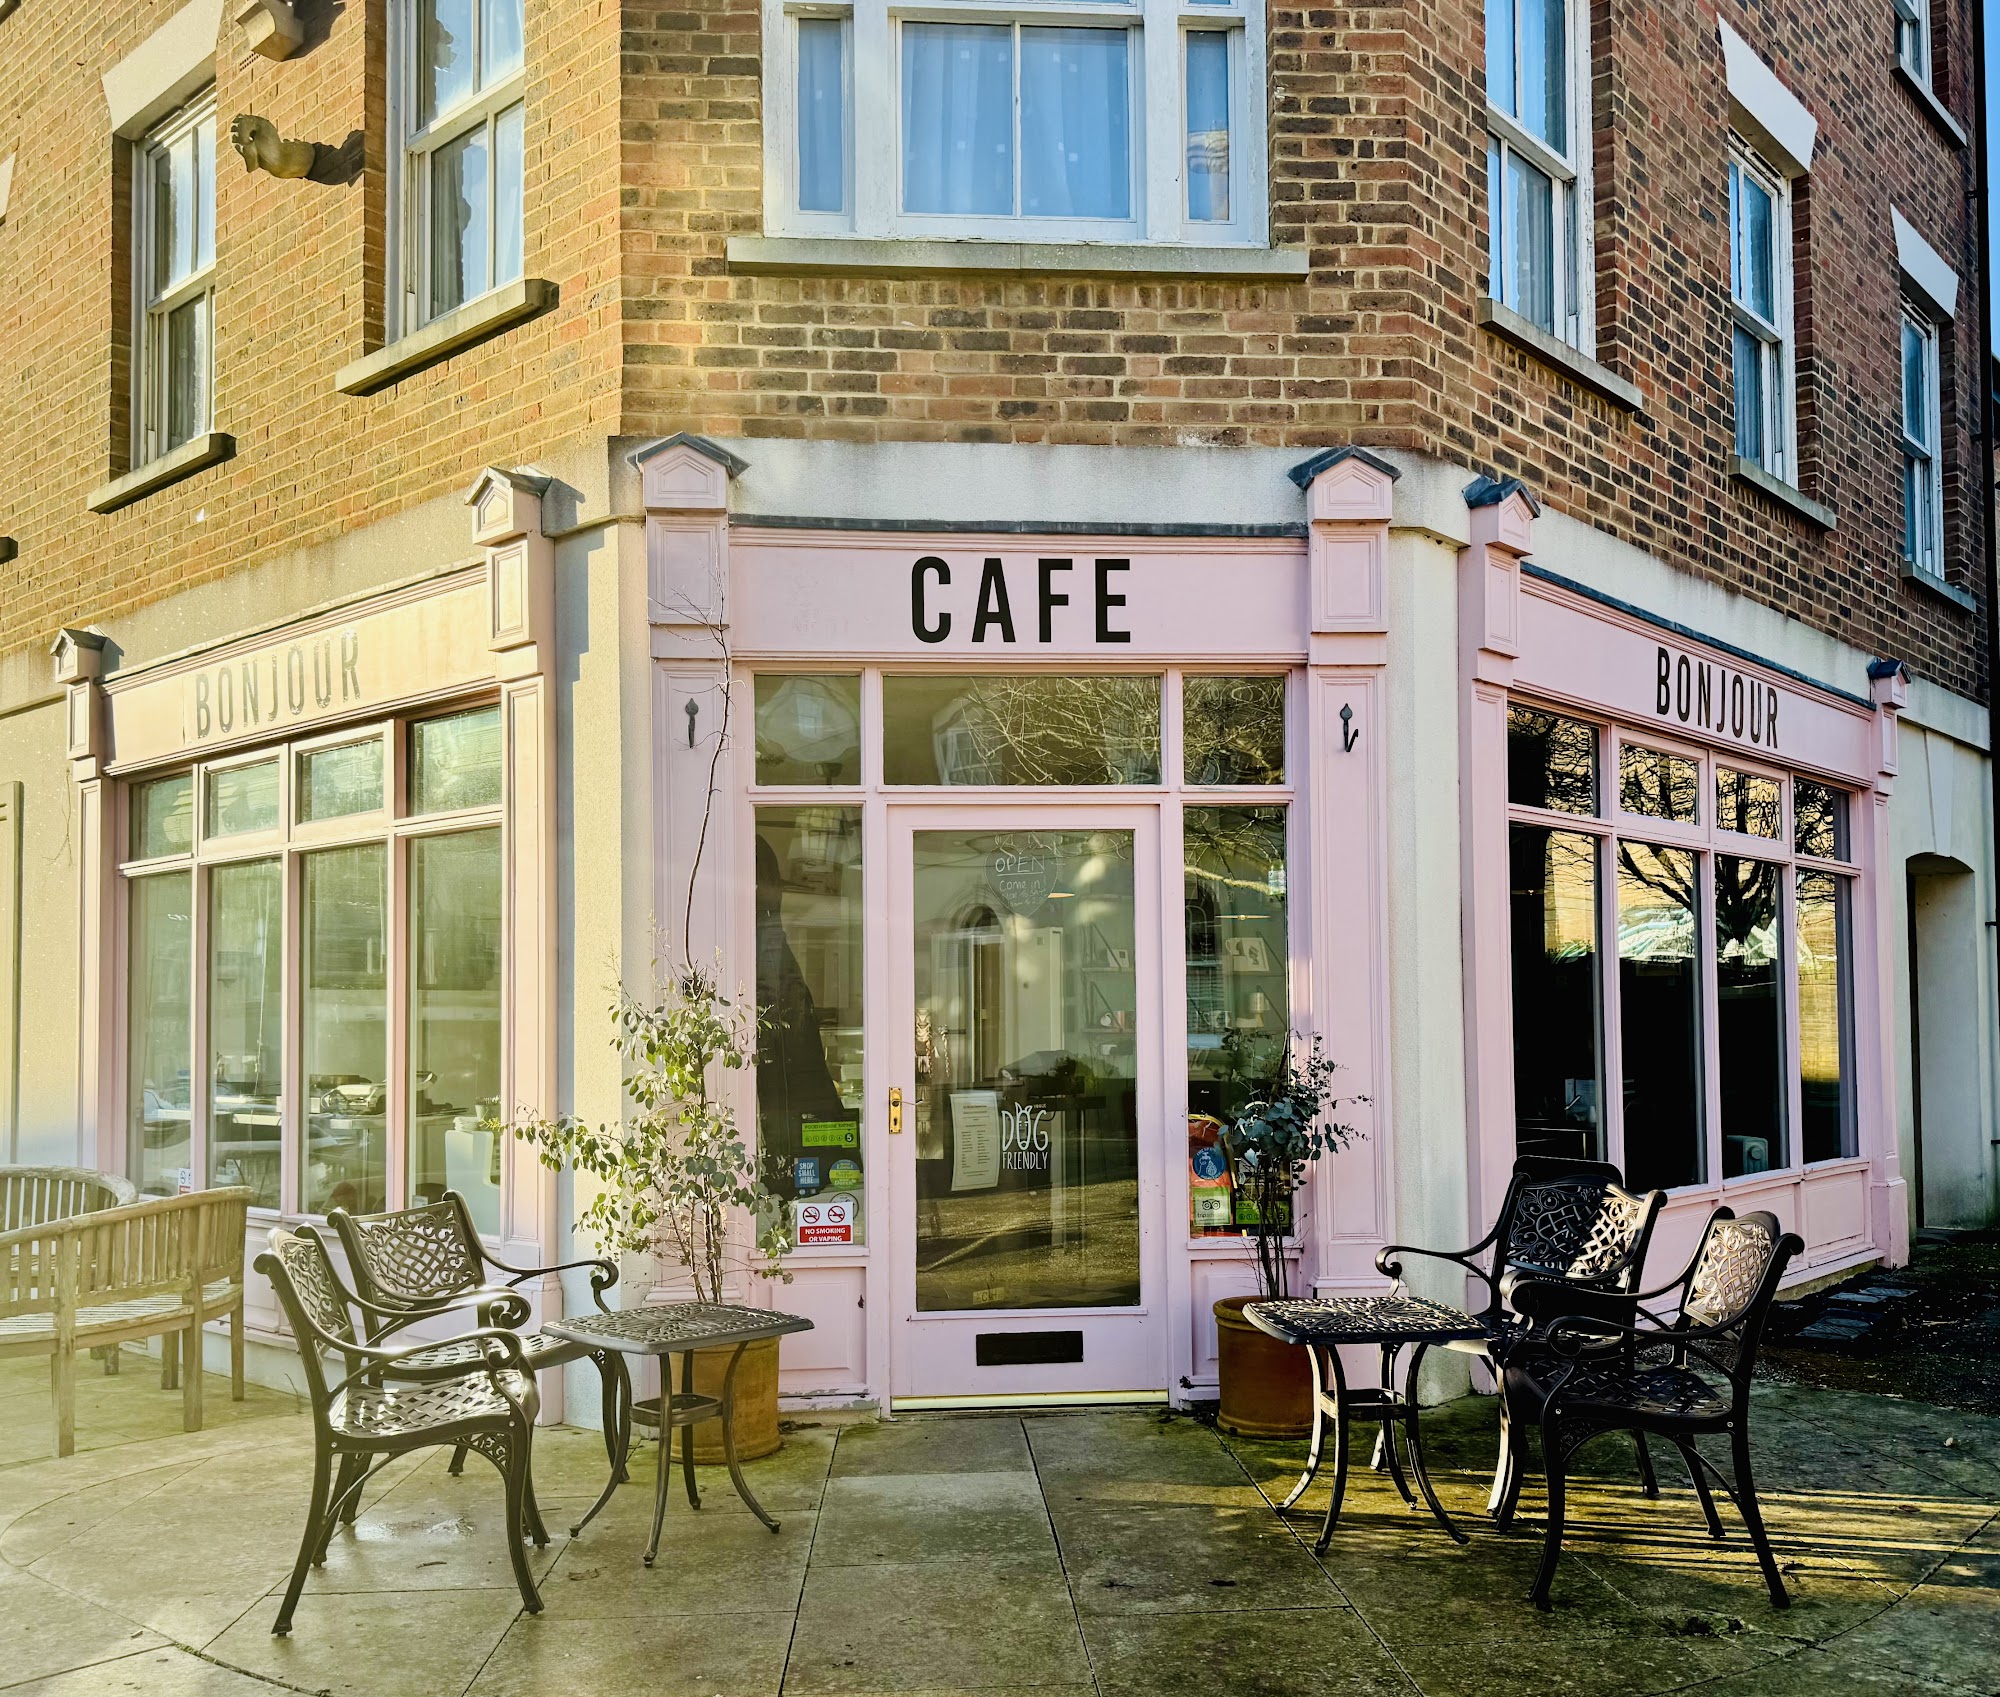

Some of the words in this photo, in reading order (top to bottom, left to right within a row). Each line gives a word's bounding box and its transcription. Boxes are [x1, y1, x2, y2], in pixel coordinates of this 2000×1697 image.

[911, 556, 1131, 643] CAFE
[195, 628, 361, 740] BONJOUR
[1656, 646, 1778, 749] BONJOUR
[995, 854, 1045, 873] OPEN
[1001, 1103, 1049, 1151] DOG
[799, 1162, 814, 1170] SHOP
[1002, 1152, 1048, 1169] FRIENDLY
